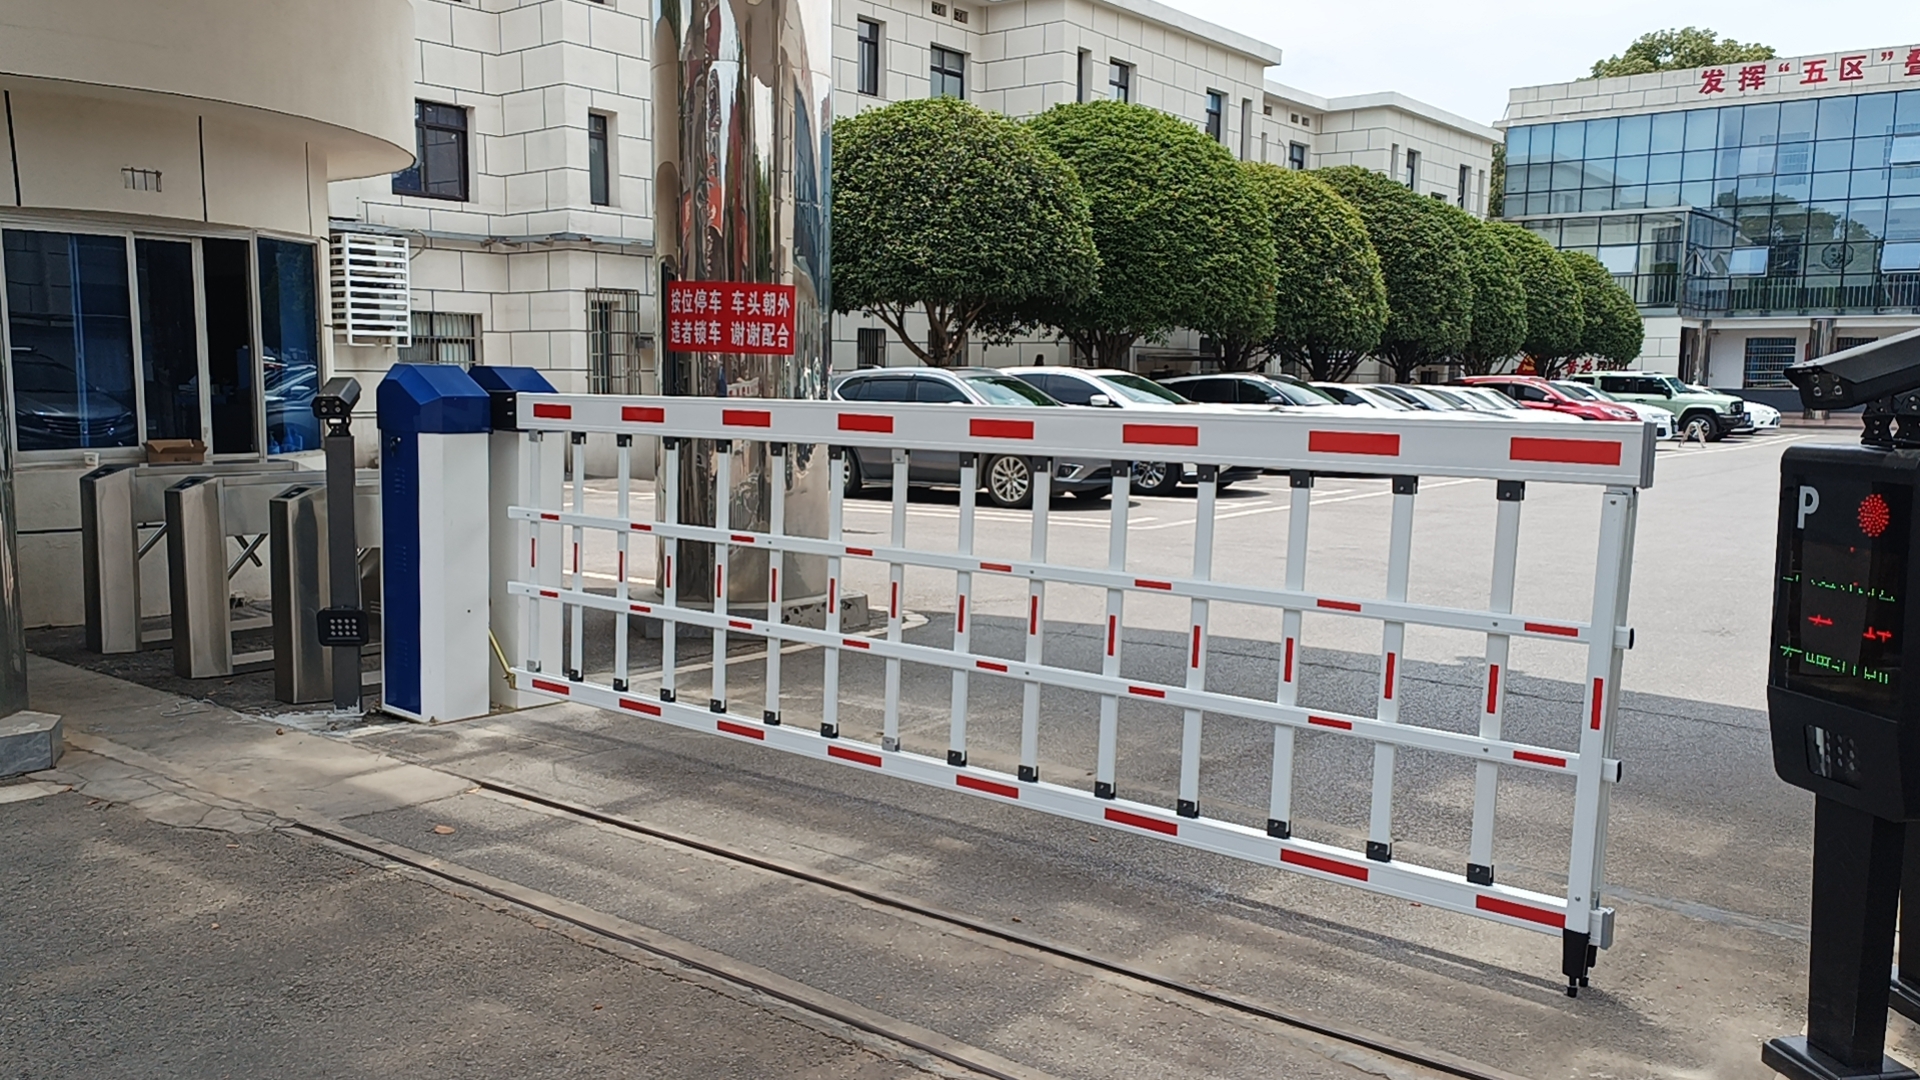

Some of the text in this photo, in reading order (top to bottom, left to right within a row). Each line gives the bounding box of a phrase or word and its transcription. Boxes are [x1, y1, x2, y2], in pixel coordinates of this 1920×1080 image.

[670, 288, 791, 318] 按位停车 车头朝外
[730, 321, 791, 349] 谢谢配合
[1797, 485, 1820, 530] P
